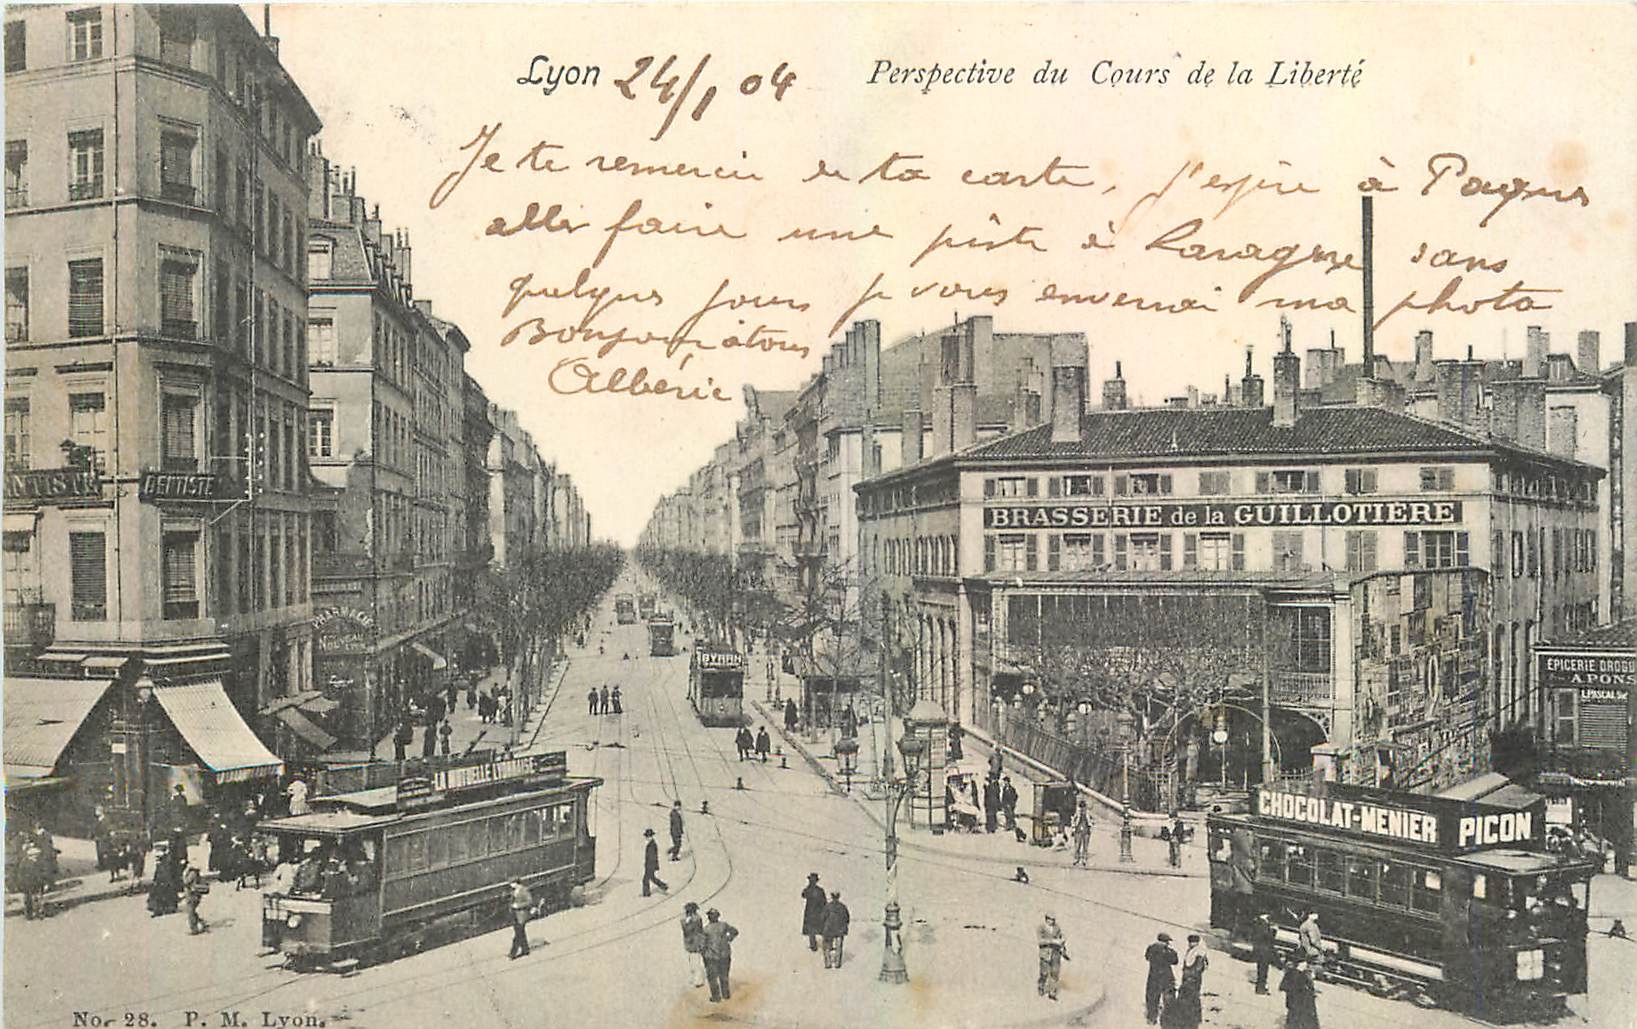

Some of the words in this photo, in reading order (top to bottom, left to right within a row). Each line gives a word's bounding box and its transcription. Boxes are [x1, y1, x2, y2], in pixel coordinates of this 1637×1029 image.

[428, 122, 504, 209] Je
[516, 140, 570, 171] te
[858, 151, 931, 182] ta
[1357, 155, 1400, 193] à
[1255, 296, 1358, 315] ma
[990, 505, 1162, 527] BRASSERIE
[1170, 507, 1197, 526] de
[1205, 506, 1226, 525] la
[1258, 790, 1438, 844] CHOCOLAT-MENIER
[1458, 812, 1532, 847] PICON
